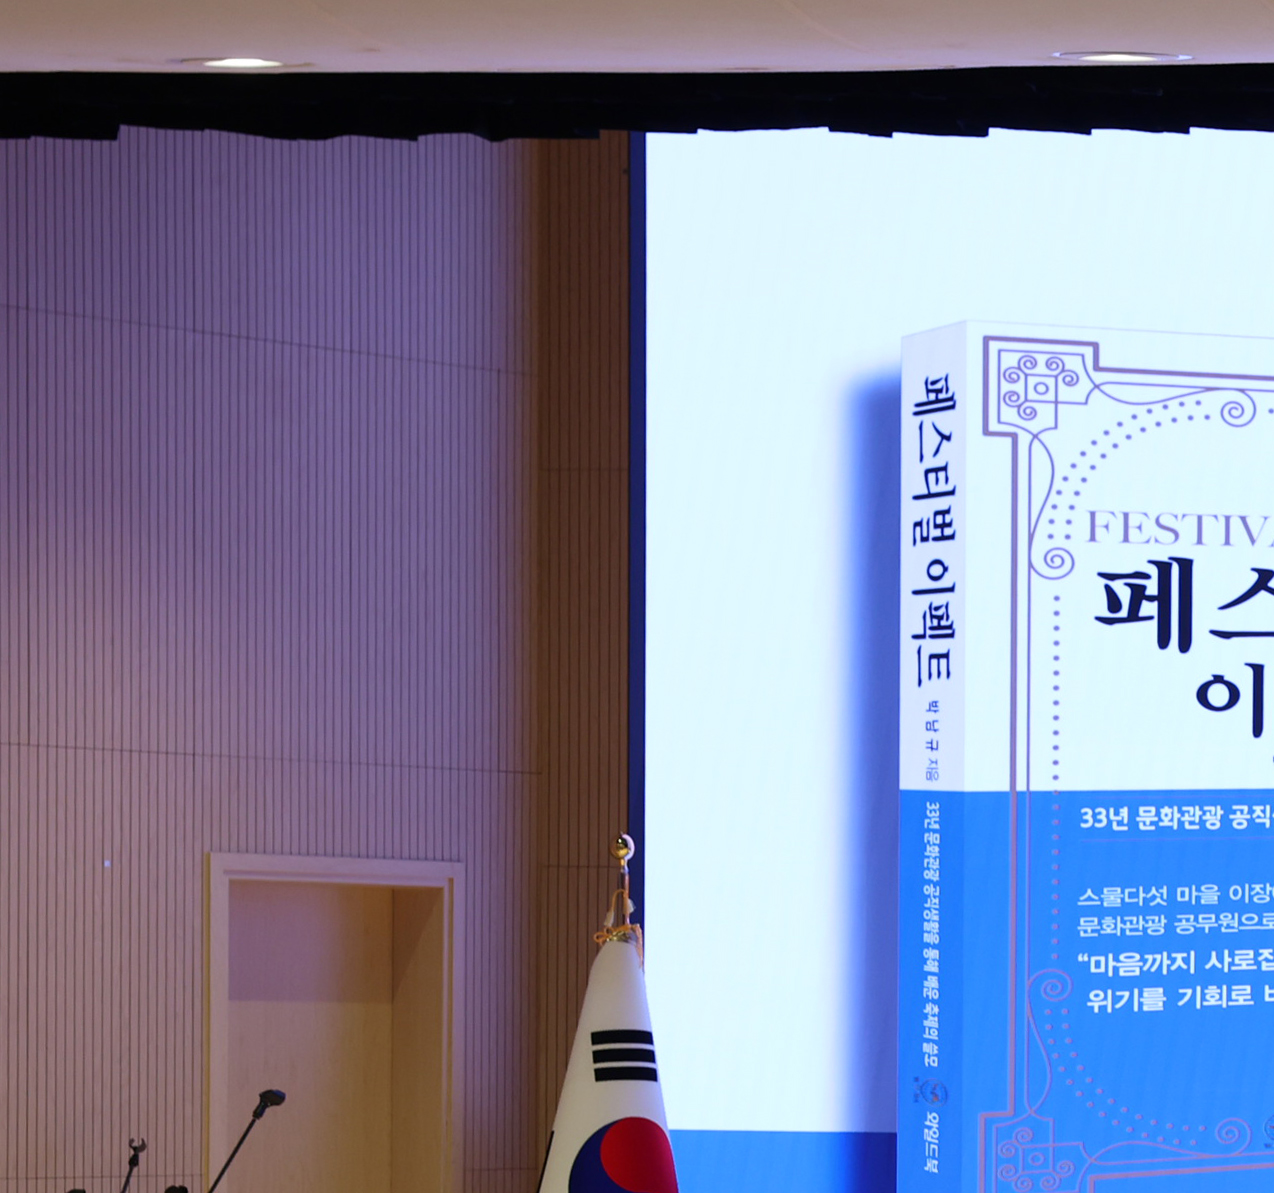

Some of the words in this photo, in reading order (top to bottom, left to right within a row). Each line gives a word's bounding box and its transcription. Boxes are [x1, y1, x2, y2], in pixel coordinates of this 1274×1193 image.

[912, 373, 956, 547] 페스티벌
[911, 558, 956, 688] 이펙트
[925, 758, 940, 782] 지음
[924, 801, 940, 829] 33년
[1080, 806, 1129, 831] 33년
[1135, 805, 1224, 831] 문화관광
[923, 831, 940, 881] 문화관광
[1077, 885, 1168, 908] 스물다섯
[1176, 883, 1221, 905] 마을
[923, 884, 940, 945] 공직생활을
[1077, 914, 1168, 938] 문화관광
[923, 947, 940, 973] 통해
[923, 975, 940, 1000] 배운
[1086, 987, 1167, 1014] 위기를
[1177, 984, 1255, 1010] 기회로
[923, 1002, 940, 1041] 축제의
[922, 1042, 939, 1068] 쓸모
[923, 1111, 940, 1174] 와일드북
